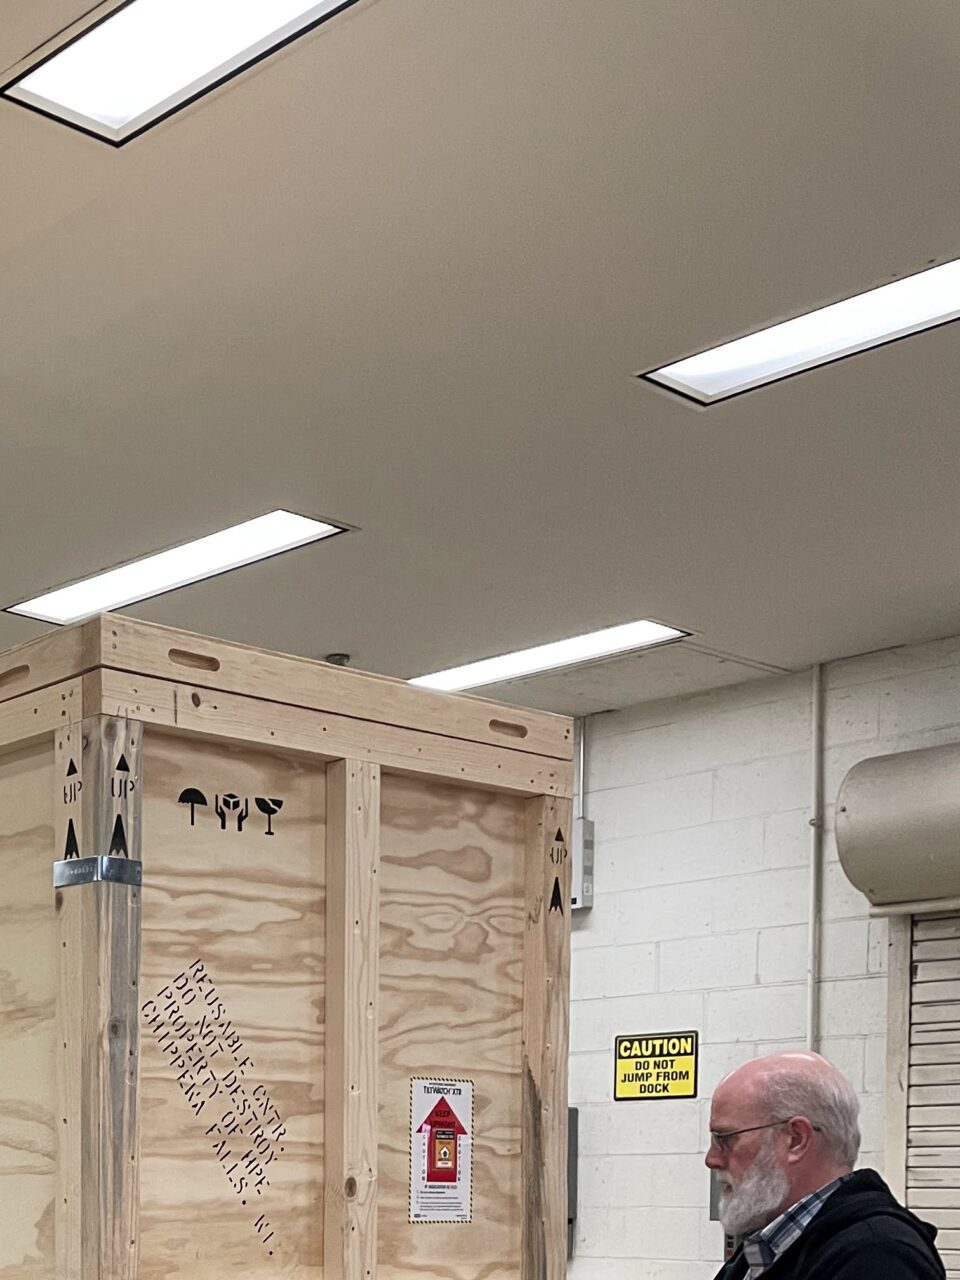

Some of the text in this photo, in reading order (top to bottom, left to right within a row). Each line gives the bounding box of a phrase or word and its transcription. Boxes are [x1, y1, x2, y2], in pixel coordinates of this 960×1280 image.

[64, 780, 83, 804] UP
[111, 777, 135, 799] UP
[549, 847, 568, 865] UP
[188, 958, 286, 1152] REUSABLE CNTR.
[620, 1037, 692, 1057] CAUTION
[172, 972, 278, 1166] DO NOT DESTROY
[635, 1059, 676, 1071] DO NOT
[621, 1070, 690, 1083] JUMP FROM
[157, 986, 270, 1195] PROPERTY OF HPE
[639, 1083, 670, 1094] DOCK
